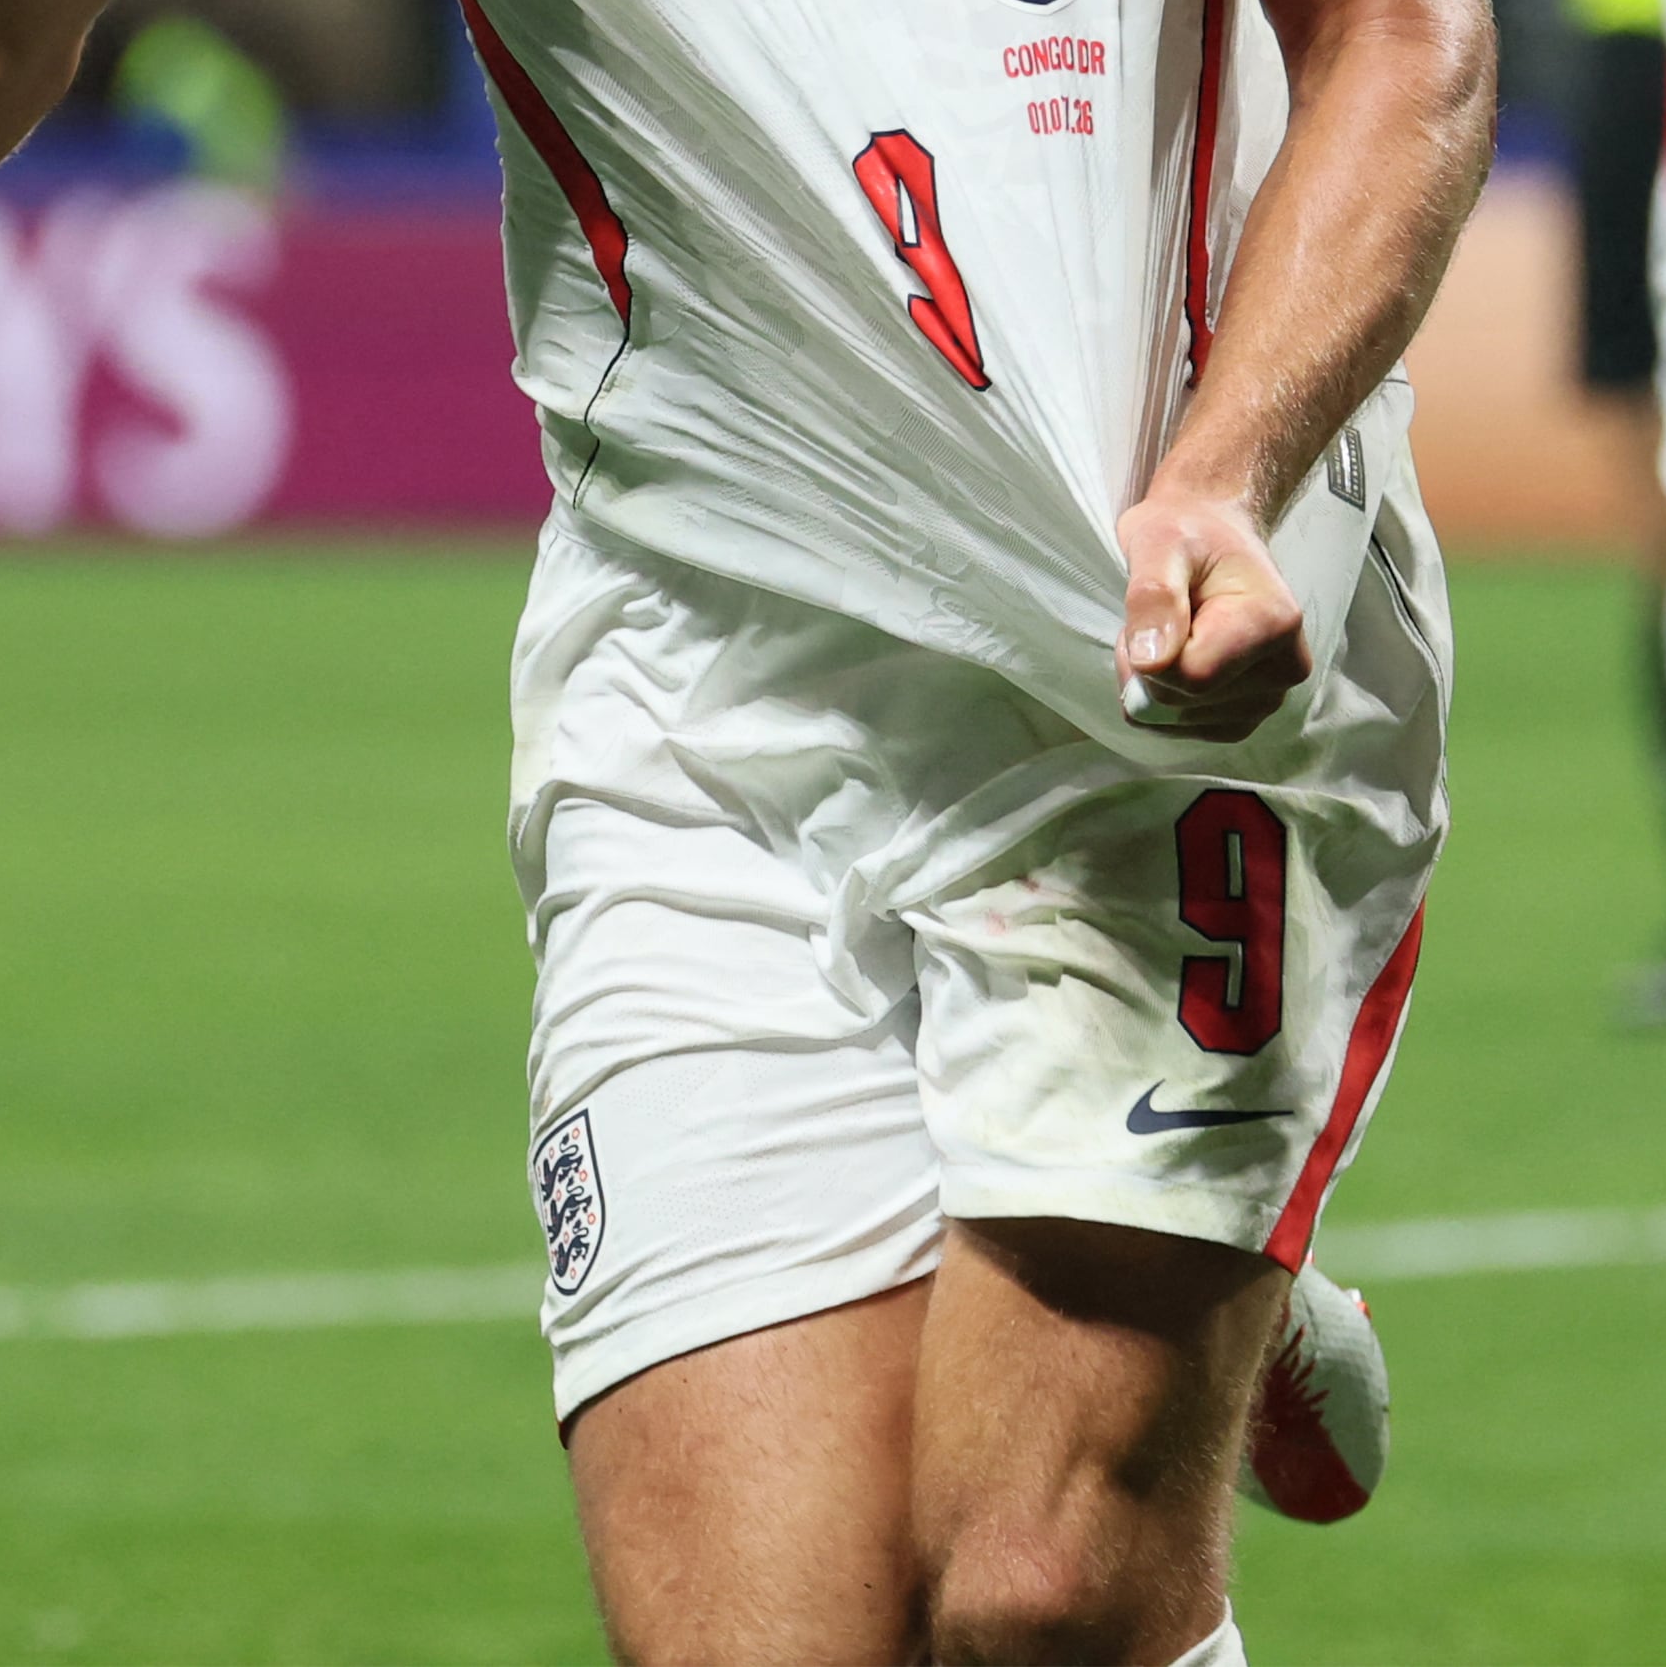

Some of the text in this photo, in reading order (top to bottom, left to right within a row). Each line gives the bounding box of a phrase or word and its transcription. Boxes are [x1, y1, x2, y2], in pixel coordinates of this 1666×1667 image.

[1002, 36, 1105, 78] CONGO DR
[852, 129, 992, 392] 9
[1174, 788, 1287, 1056] 9
